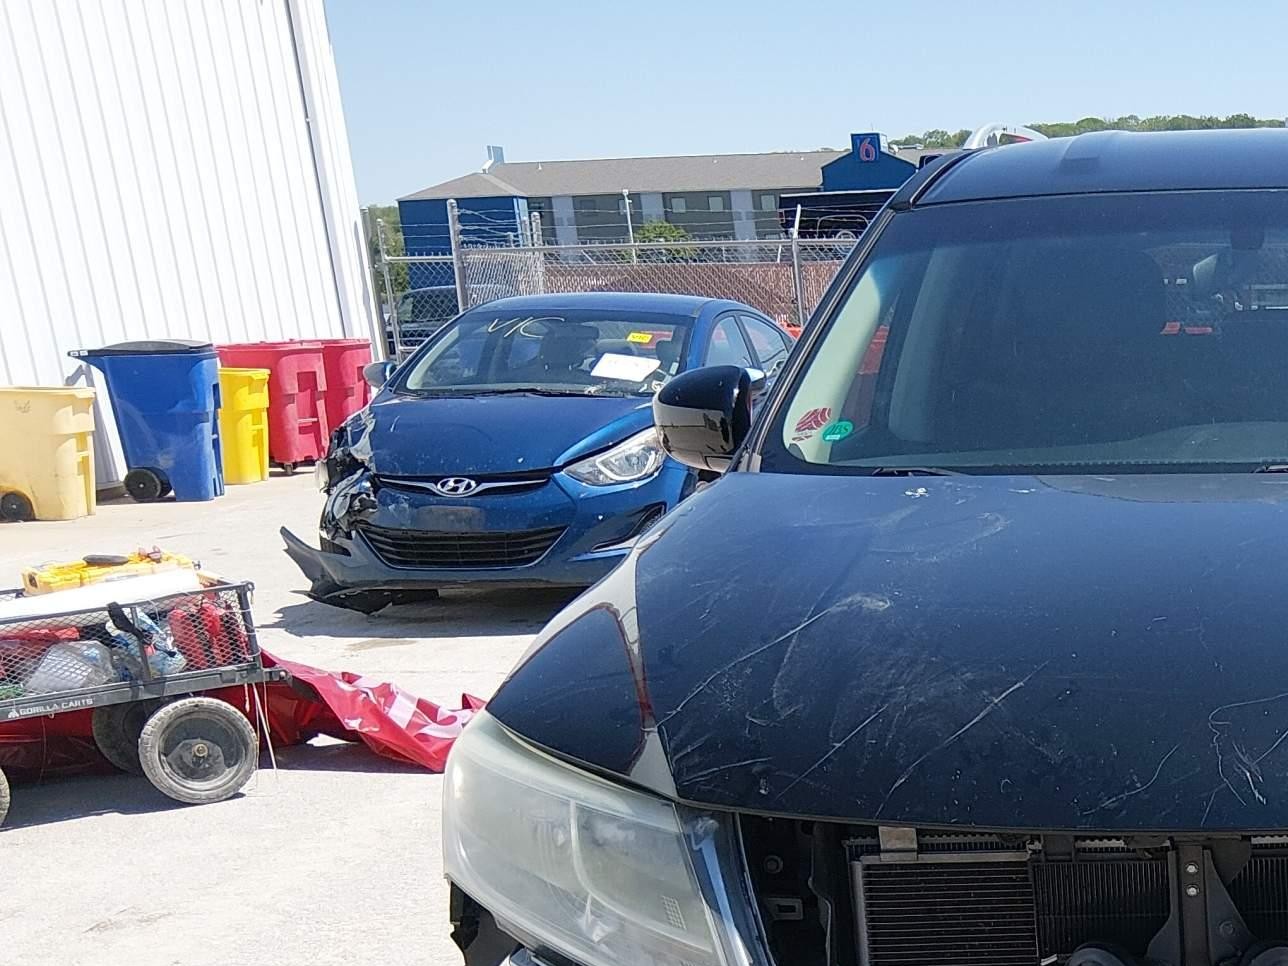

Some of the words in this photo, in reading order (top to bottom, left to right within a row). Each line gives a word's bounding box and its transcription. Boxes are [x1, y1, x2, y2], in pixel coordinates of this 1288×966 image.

[859, 137, 876, 161] 6
[19, 703, 58, 716] GORILLA
[61, 698, 94, 709] CARTS
